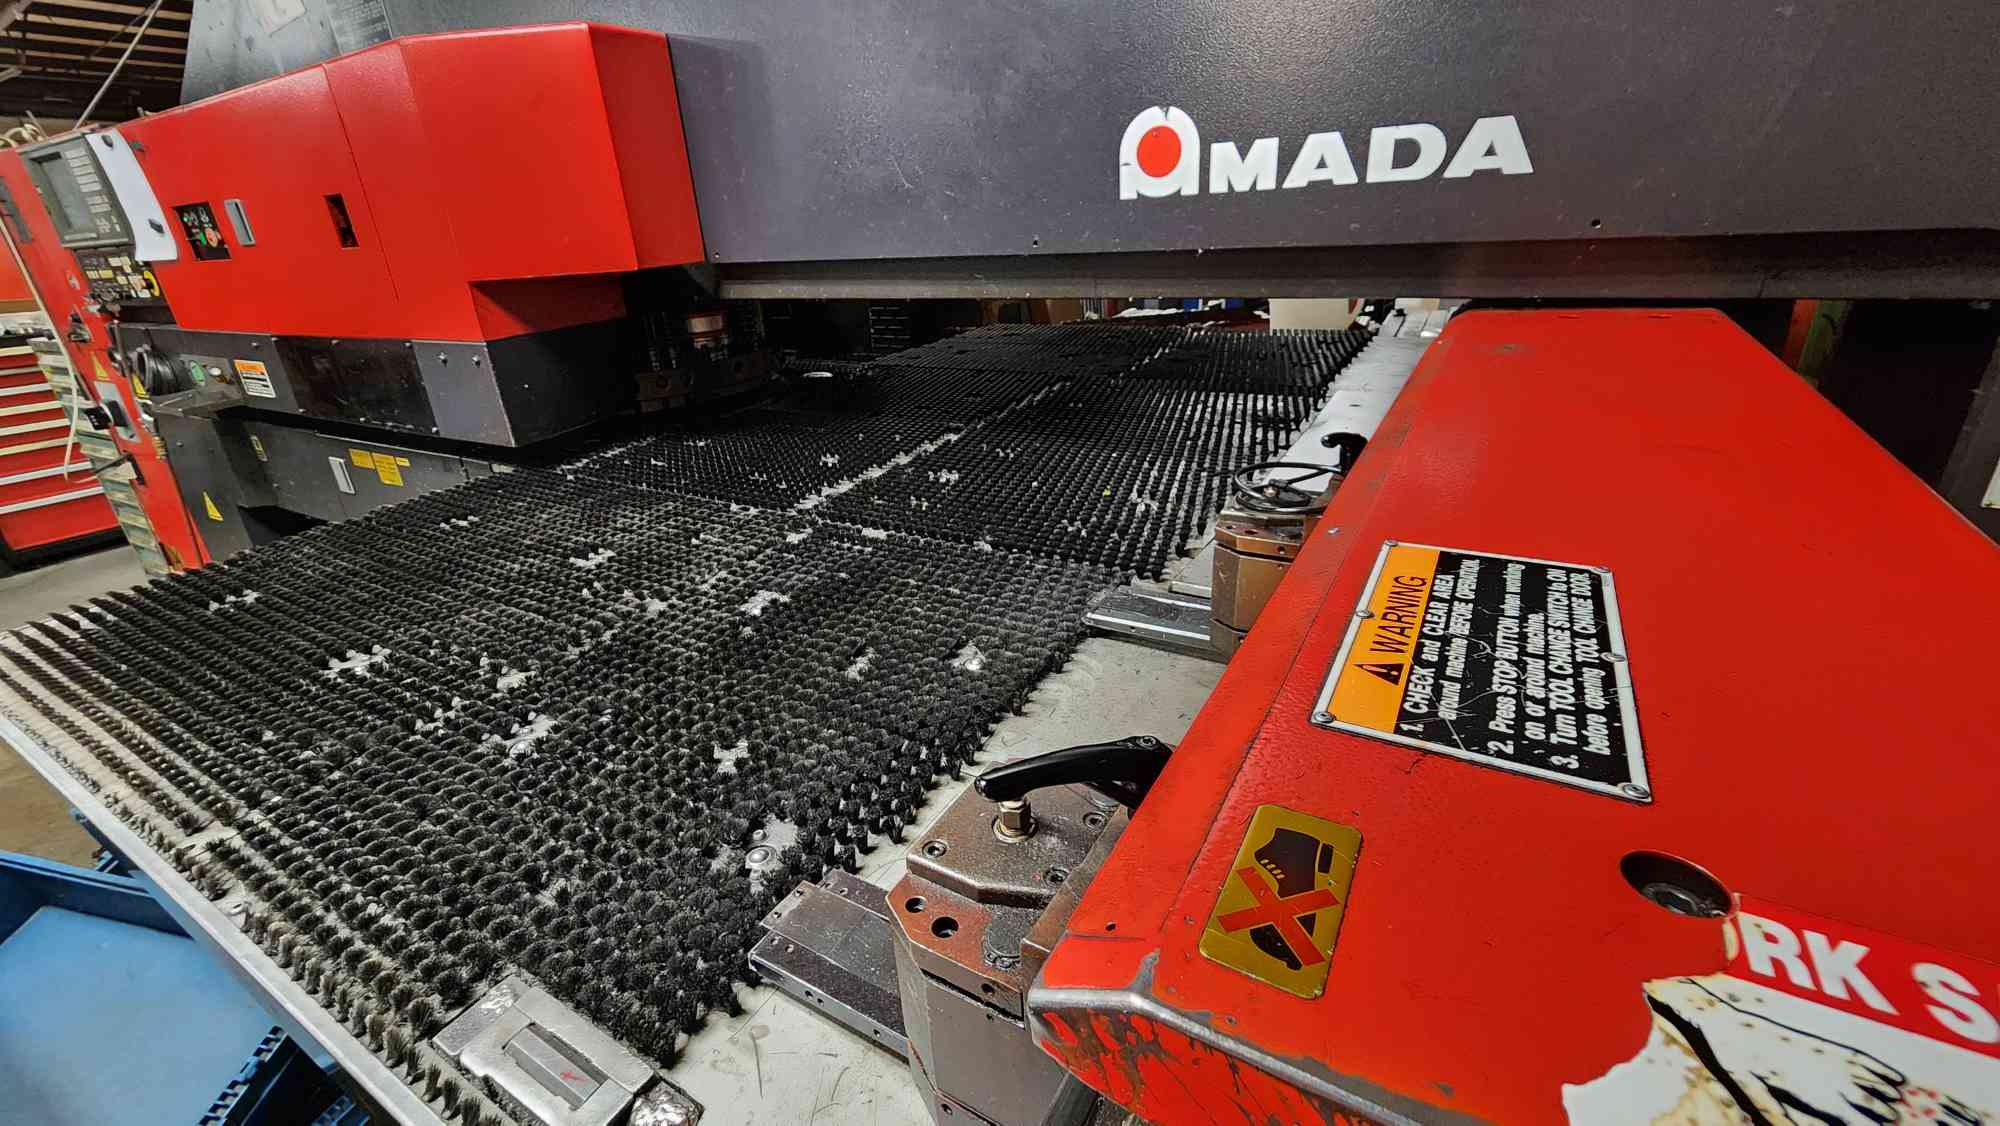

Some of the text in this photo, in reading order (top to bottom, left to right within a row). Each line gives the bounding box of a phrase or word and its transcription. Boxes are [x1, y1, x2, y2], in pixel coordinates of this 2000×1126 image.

[1119, 105, 1534, 201] AMADA
[1369, 575, 1428, 654] WARNING
[1448, 600, 1474, 635] BEFORE
[1570, 598, 1597, 634] CHANGE
[1400, 574, 1455, 733] 1. CHECK and CLEAR AREA
[1444, 637, 1469, 678] machine
[1487, 562, 1526, 755] 2. Press STOP BUTTON when working
[1522, 612, 1546, 740] on or around machine.
[1546, 568, 1580, 770] 3. Turn TOOL CHANGE SWITCH to ON
[1573, 638, 1600, 663] TOOL
[1438, 679, 1462, 720] around
[1577, 667, 1610, 710] opening
[1582, 713, 1611, 755] before
[1723, 910, 2000, 1044] RK S
